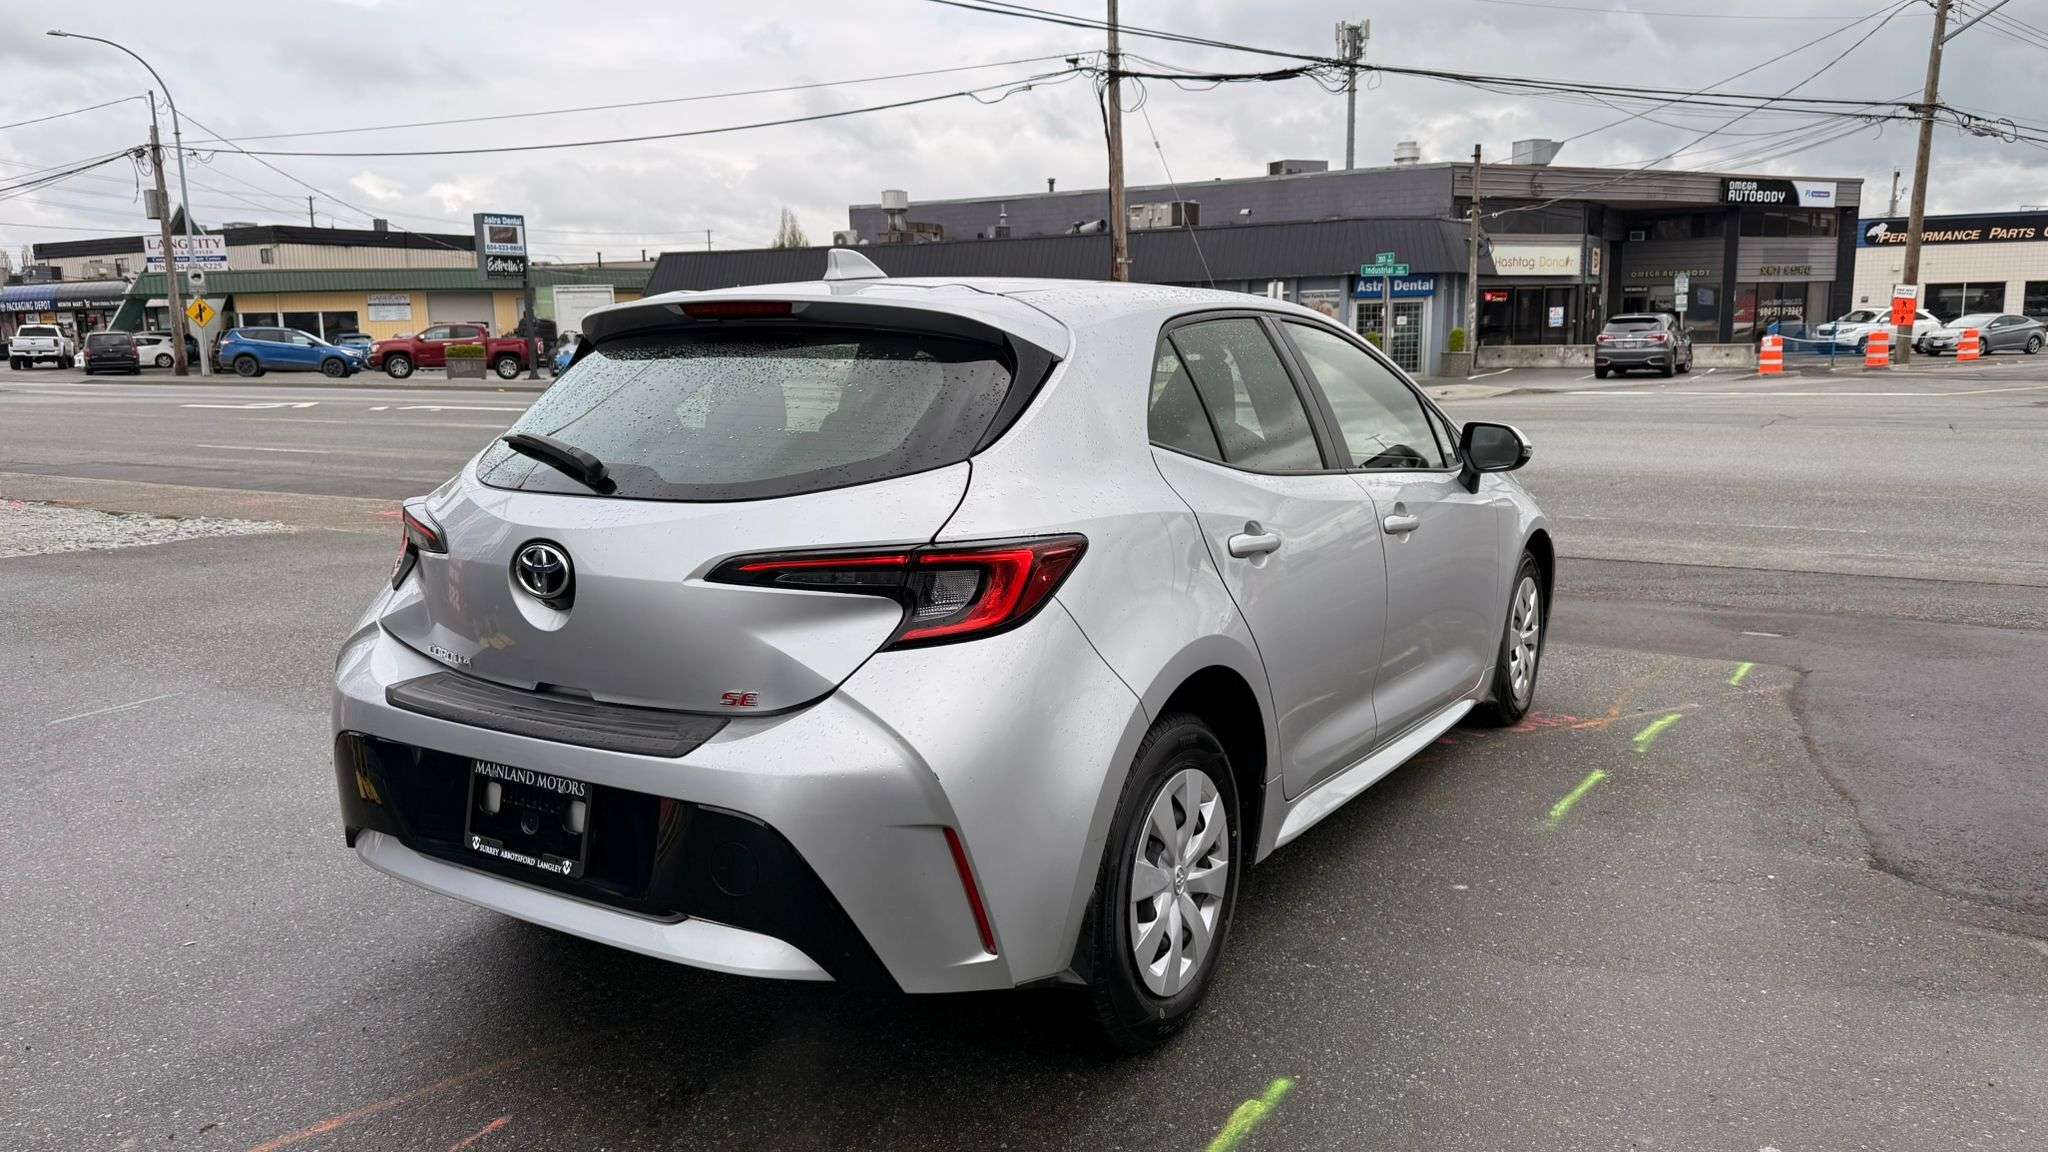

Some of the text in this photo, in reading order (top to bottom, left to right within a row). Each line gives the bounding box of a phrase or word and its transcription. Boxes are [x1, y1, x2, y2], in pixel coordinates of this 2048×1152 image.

[1729, 180, 1758, 191] OMEGA
[1728, 190, 1786, 203] AUTOBODY
[484, 216, 522, 225] Astra Dental
[1989, 227, 2036, 239] PARTS
[487, 256, 524, 272] Estrella's
[1495, 256, 1535, 269] Hashtag
[1365, 266, 1393, 274] Industrial
[1357, 279, 1434, 292] Astr Dental
[6, 301, 34, 311] PACKAGING
[34, 300, 51, 310] DEPOT
[720, 690, 759, 707] SE
[475, 761, 586, 797] MAINLAND MOTORS
[479, 843, 562, 874] SURREY ABBOTSFORD LANGLEY
